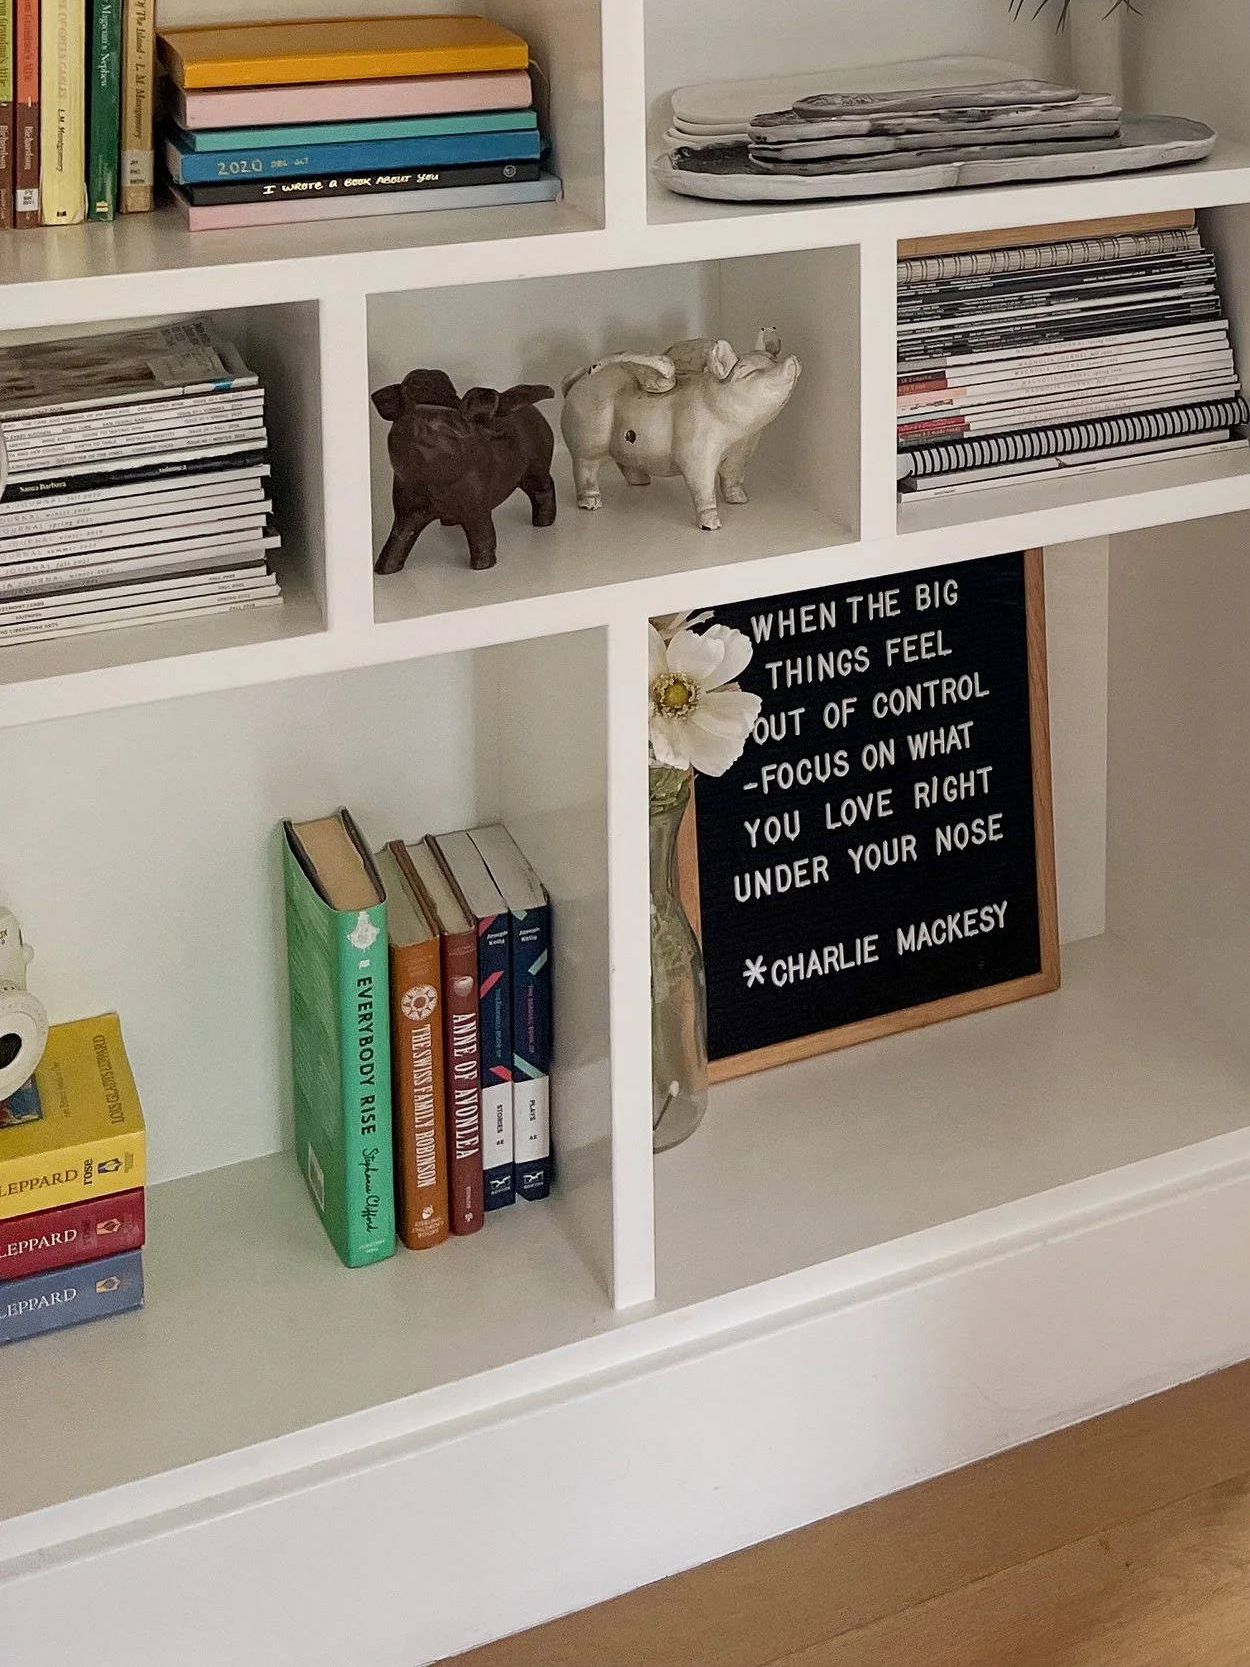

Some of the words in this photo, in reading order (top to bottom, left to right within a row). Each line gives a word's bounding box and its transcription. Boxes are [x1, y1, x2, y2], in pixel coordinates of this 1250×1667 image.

[57, 12, 67, 27] OF
[99, 5, 113, 52] Magician's
[135, 10, 145, 27] The
[57, 27, 67, 60] GREEN
[135, 28, 145, 54] Island
[57, 61, 67, 101] GABLES
[99, 53, 111, 89] Nephew
[135, 62, 144, 72] L.
[135, 74, 144, 86] M.
[55, 108, 65, 124] L.M.
[133, 88, 145, 139] Montgomery
[0, 124, 8, 169] Richardson
[24, 126, 33, 170] Richardson
[55, 126, 65, 173] Montgomery
[218, 159, 263, 176] 2020
[263, 186, 275, 195] I
[344, 177, 371, 188] BOOK
[376, 175, 411, 186] ABOUT
[20, 484, 39, 494] Santa
[40, 481, 67, 490] Barbara
[751, 600, 836, 643] WHEN
[846, 589, 901, 624] THE
[915, 578, 959, 611] BIG
[765, 645, 869, 690] THINGS
[886, 629, 952, 667] FEEL
[752, 707, 806, 745] OUT
[823, 697, 858, 730] OF
[872, 672, 990, 719] CONTROL
[861, 738, 895, 772] ON
[906, 721, 974, 761] WHAT
[744, 810, 800, 849] YOU
[825, 789, 892, 830] LOVE
[914, 766, 992, 810] RIGHT
[733, 855, 830, 903] UNDER
[848, 834, 917, 874] YOUR
[936, 813, 1003, 856] NOSE
[897, 901, 1007, 955] MACKESY
[357, 976, 376, 1086] EVERYBODY
[411, 1024, 431, 1049] THE
[453, 1013, 476, 1058] ANNE
[92, 1035, 112, 1072] LEPPARD
[412, 1049, 432, 1084] SWISS
[455, 1061, 477, 1080] OF
[100, 1071, 120, 1103] GLADYS
[109, 1103, 125, 1125] LOIS
[360, 1094, 377, 1135] RISE
[413, 1085, 434, 1131] FAMILY
[456, 1090, 479, 1161] AVONLEA
[496, 1104, 504, 1134] STORIES
[83, 1158, 94, 1187] rose
[415, 1132, 437, 1187] ROBINSON
[361, 1194, 381, 1233] Clifford
